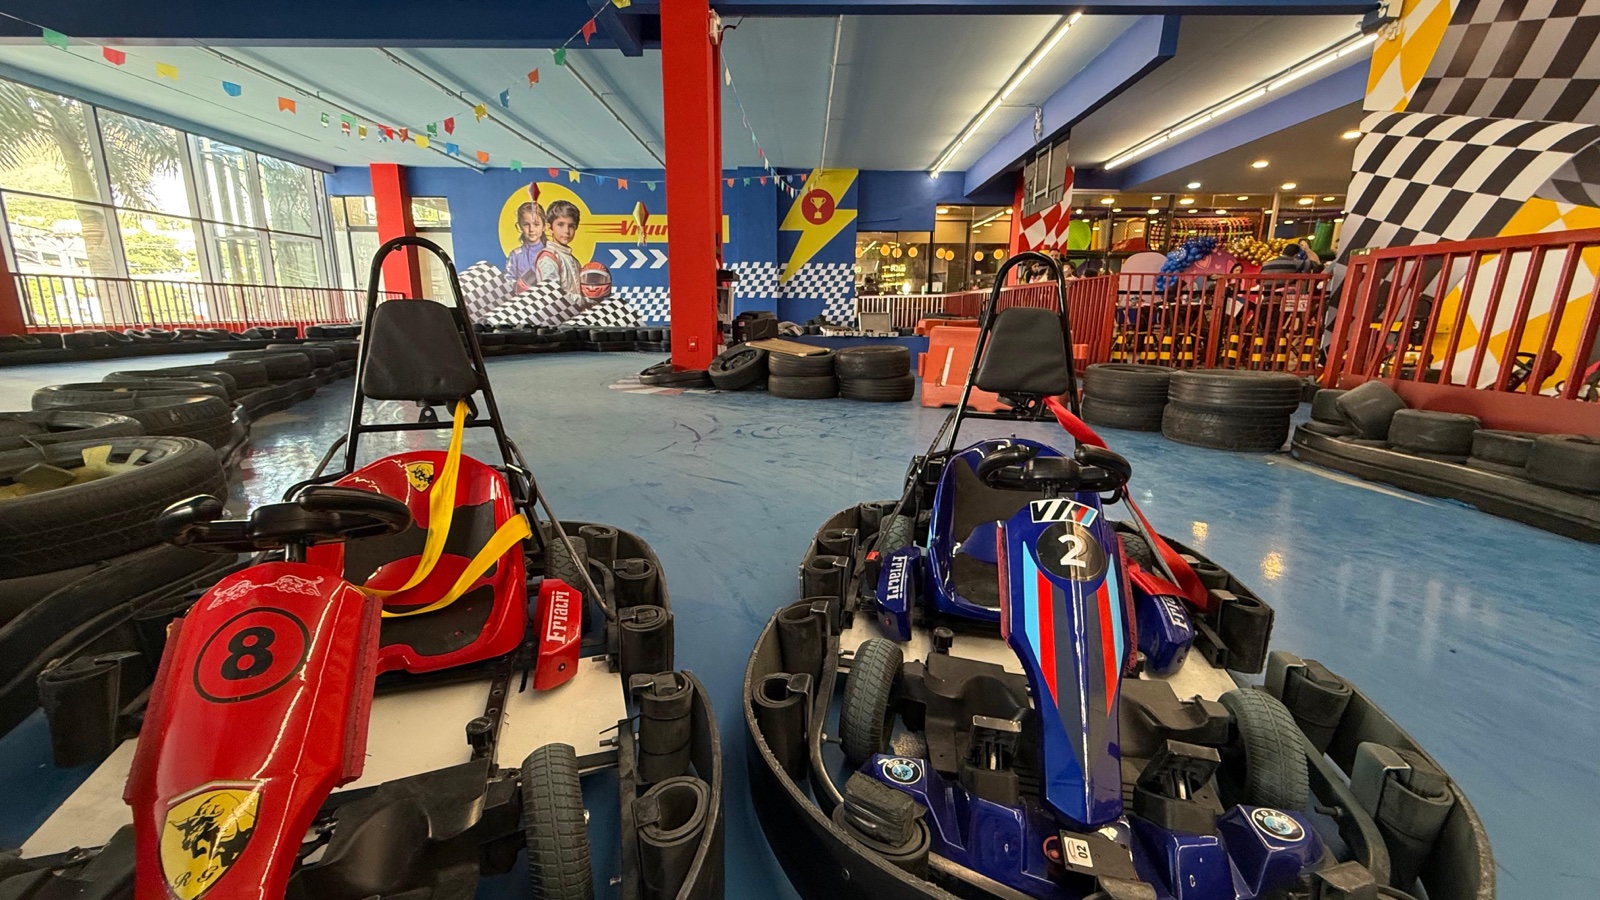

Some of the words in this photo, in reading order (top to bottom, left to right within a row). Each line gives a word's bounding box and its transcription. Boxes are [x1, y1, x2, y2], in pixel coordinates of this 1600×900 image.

[1058, 534, 1087, 568] 2
[220, 625, 276, 681] 8
[886, 759, 915, 769] MOTO
[1076, 845, 1089, 859] 02
